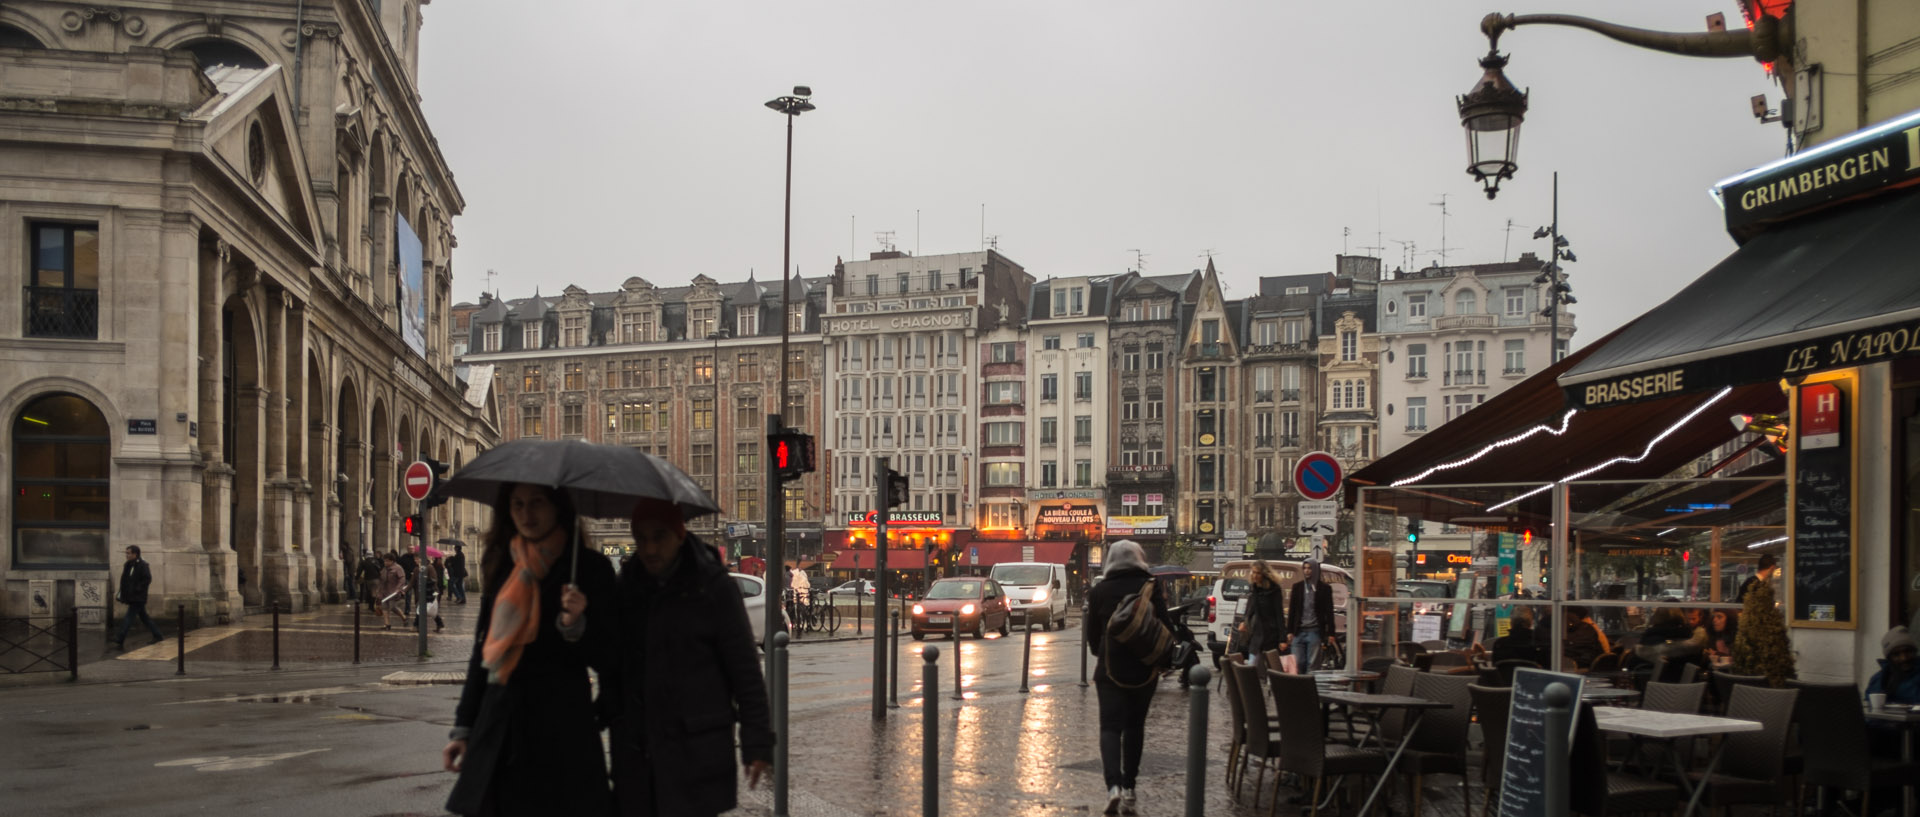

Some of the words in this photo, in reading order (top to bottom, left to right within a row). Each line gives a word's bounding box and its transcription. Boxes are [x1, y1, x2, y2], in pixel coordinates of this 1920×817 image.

[1741, 147, 1890, 210] GRIMBERGEN
[831, 319, 880, 332] HOTEL
[891, 313, 962, 329] CHAGNOT
[1783, 346, 1819, 373] LE
[1585, 369, 1684, 405] BRASSERIE
[1818, 392, 1835, 413] H
[849, 513, 864, 521] LES
[889, 512, 941, 521] BRASSEURS
